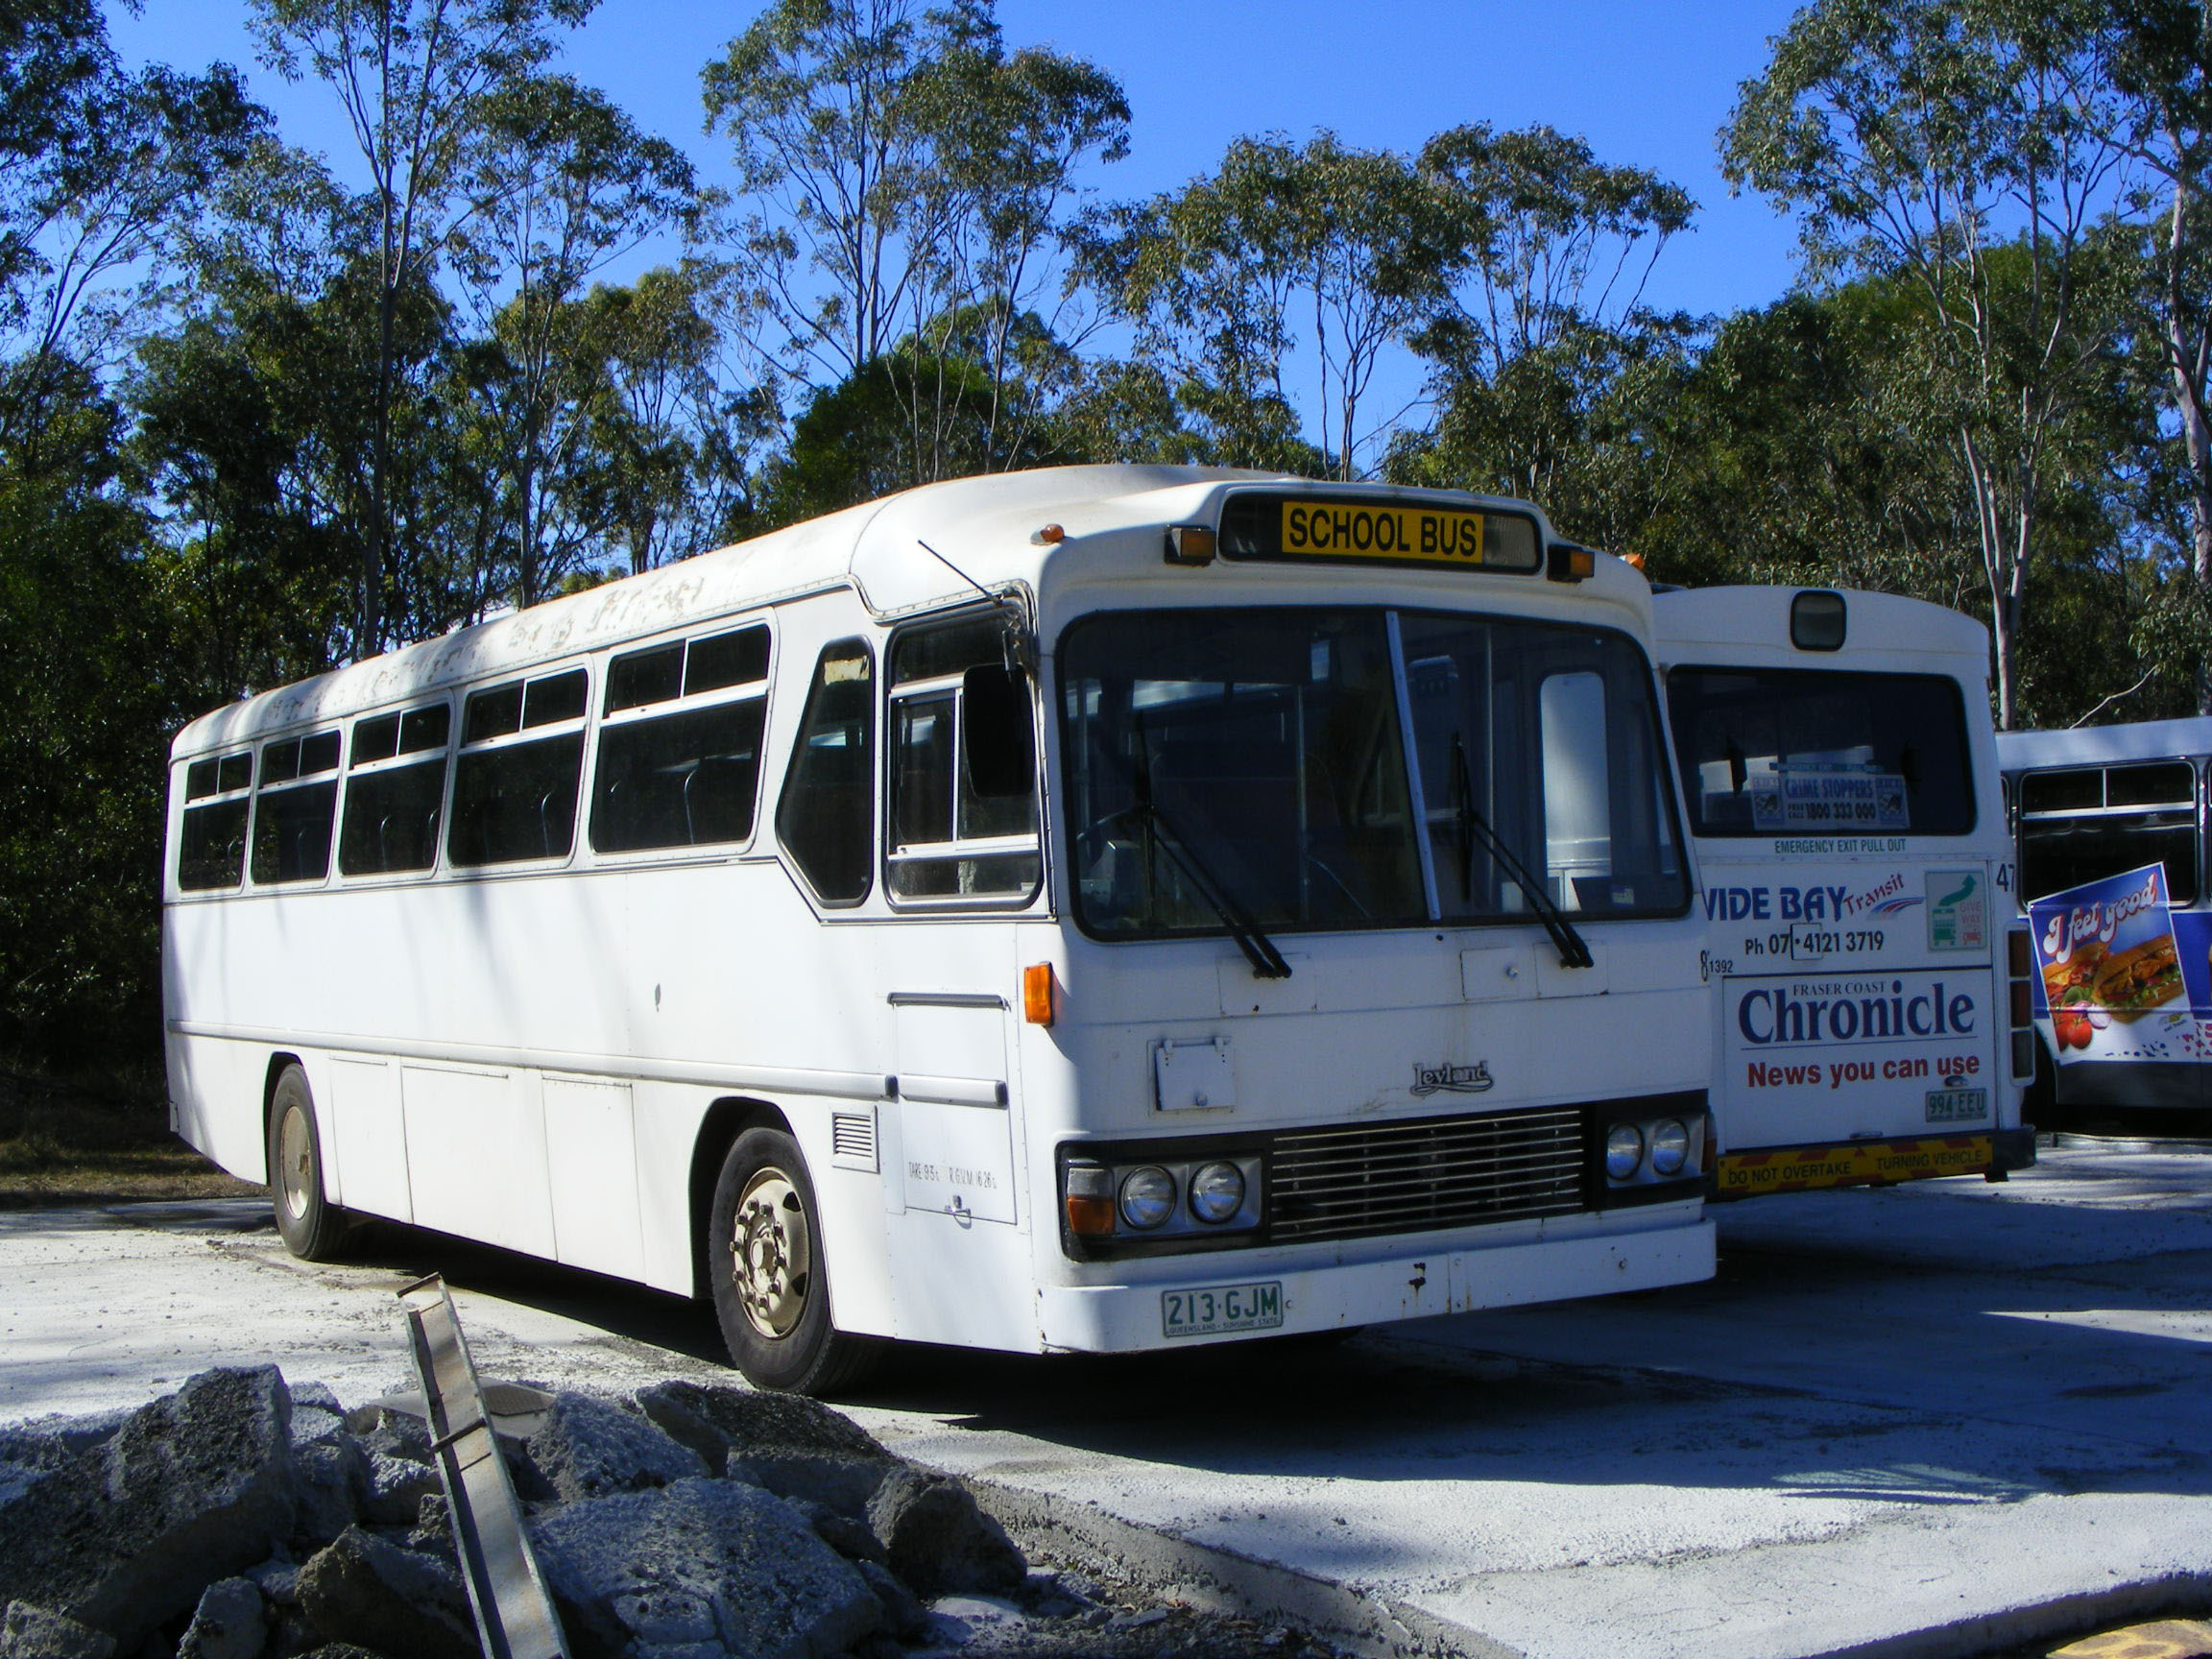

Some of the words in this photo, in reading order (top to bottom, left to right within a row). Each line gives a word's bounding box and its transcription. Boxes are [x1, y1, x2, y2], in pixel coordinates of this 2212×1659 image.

[1289, 508, 1410, 551] SCHOOL
[1420, 516, 1477, 557] BUS
[1785, 779, 1821, 799] CRIME
[1824, 778, 1872, 798] STOPPERS
[1805, 802, 1829, 820] 1800
[1775, 840, 1835, 854] EMERGENCY
[1838, 840, 1858, 853] EXIT
[1861, 839, 1884, 852] PULL
[1887, 838, 1906, 852] OUT
[1779, 886, 1846, 923] BAY
[1842, 873, 1905, 916] Transit
[2099, 872, 2159, 944] good
[1745, 938, 1764, 954] Ph
[1846, 930, 1884, 951] 3719
[1710, 960, 1734, 974] 1392
[1793, 983, 1842, 996] FRASER
[1845, 981, 1886, 995] COAST
[1739, 979, 1975, 1045] Chronicle
[1748, 1063, 1821, 1088] News
[1830, 1061, 1875, 1089] you
[1883, 1057, 1928, 1079] can
[1937, 1055, 1980, 1074] use
[1729, 1171, 1747, 1185] DO
[1751, 1168, 1777, 1182] NOT
[1783, 1162, 1851, 1180] OVERTAKE
[1877, 1153, 1929, 1171] TURNING
[1934, 1150, 1983, 1166] VEHICLE
